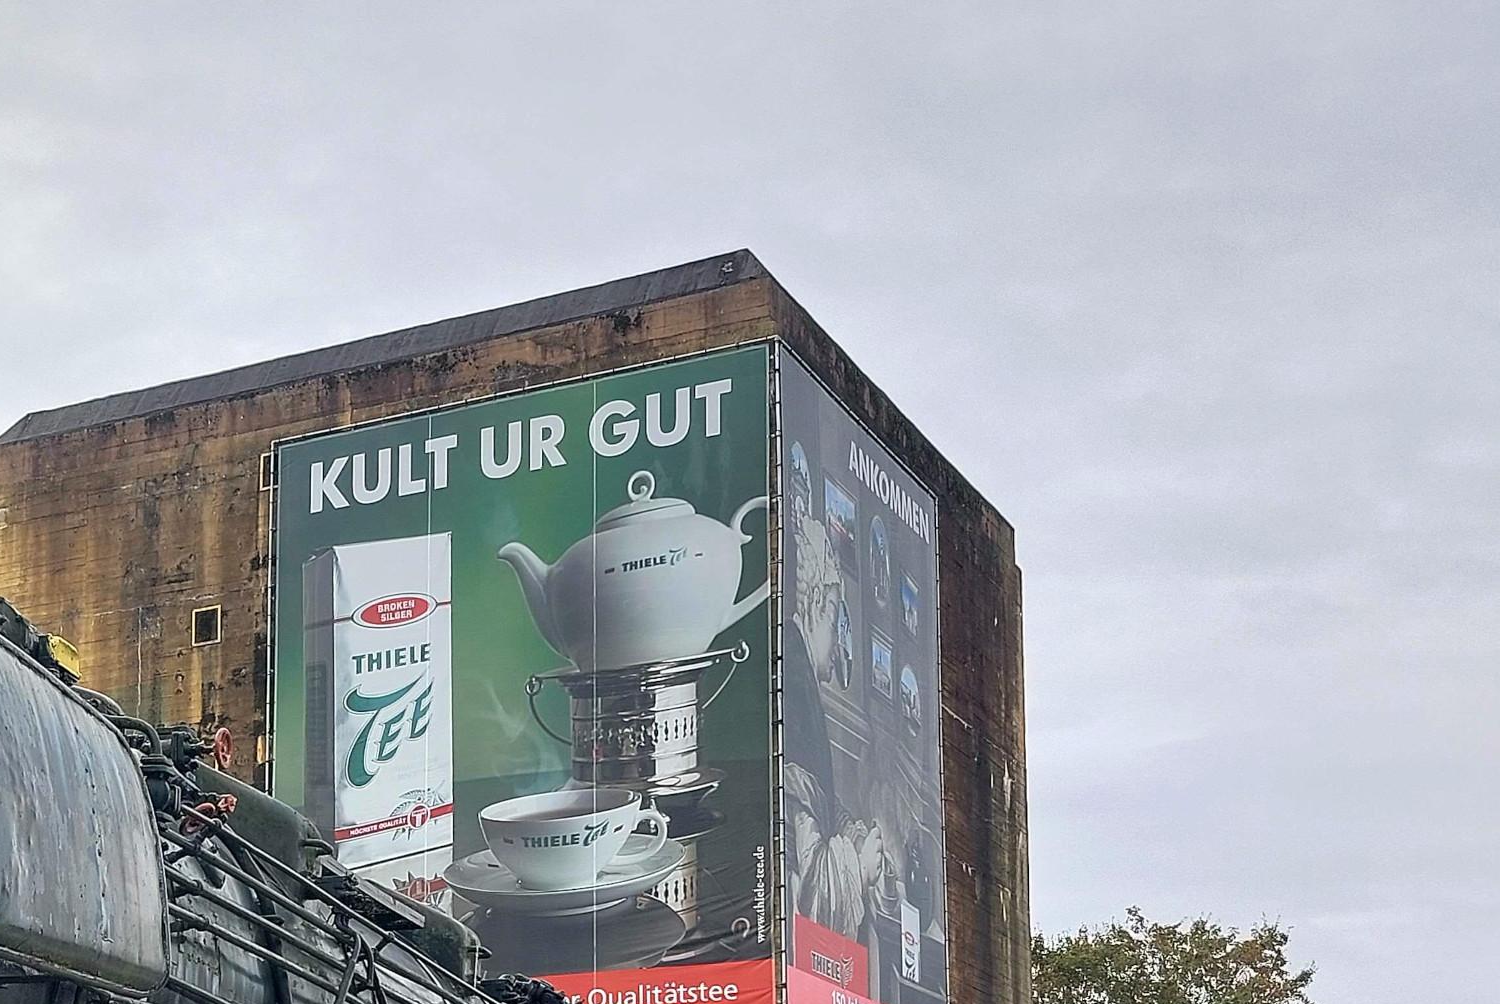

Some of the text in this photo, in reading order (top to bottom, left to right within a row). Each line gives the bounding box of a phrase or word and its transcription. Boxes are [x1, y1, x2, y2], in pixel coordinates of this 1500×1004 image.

[309, 378, 733, 514] KULT UR GUT
[849, 440, 930, 545] ANKOMMEN
[621, 555, 667, 573] THIELE
[377, 600, 415, 613] BROKEN
[352, 643, 431, 675] THIELE
[521, 833, 580, 848] THIELE
[752, 846, 766, 944] www.thiele-tee.de
[811, 950, 841, 982] THIELE
